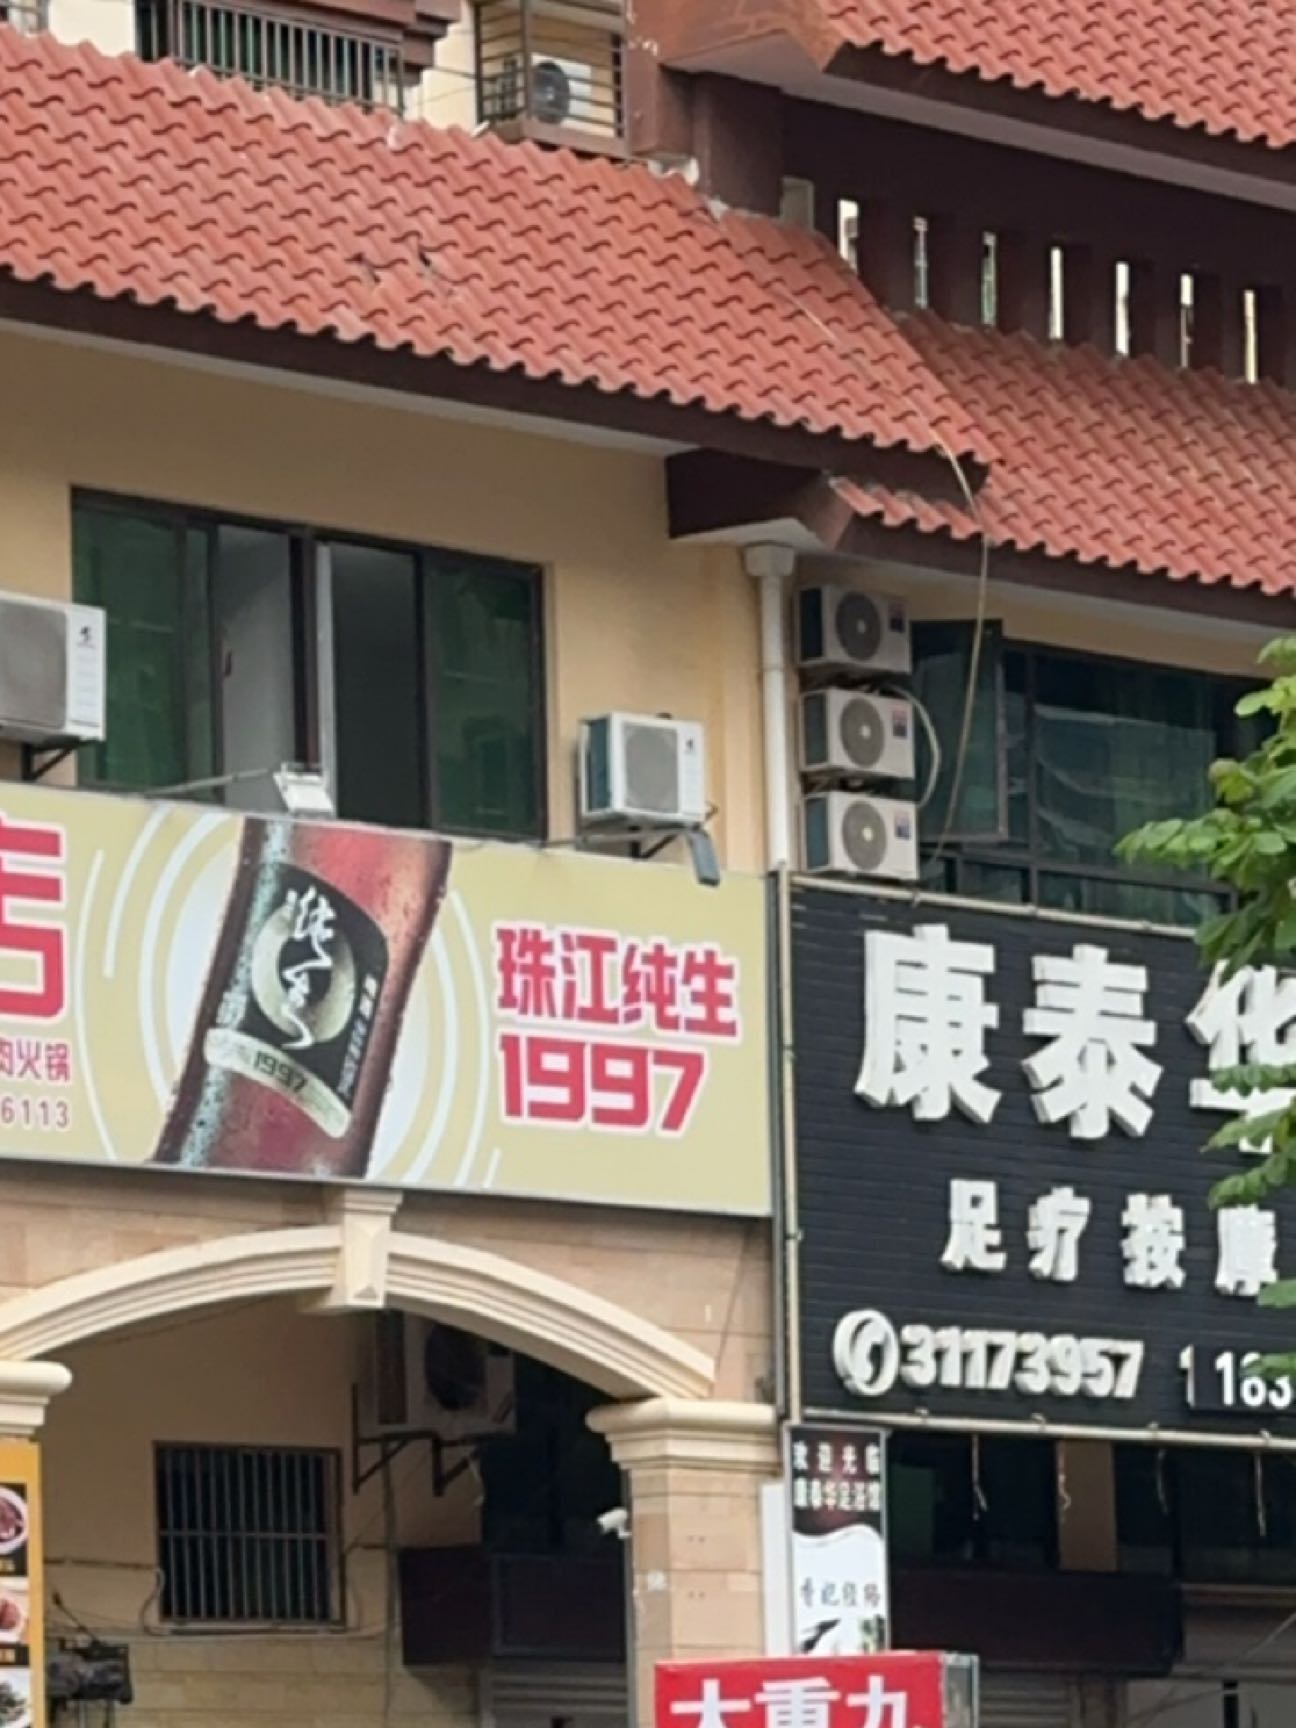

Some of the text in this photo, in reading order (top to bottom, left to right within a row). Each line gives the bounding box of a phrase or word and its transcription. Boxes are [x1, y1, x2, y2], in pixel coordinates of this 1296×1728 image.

[496, 926, 738, 1037] 珠江纯生
[255, 1051, 309, 1093] 1997
[499, 1034, 705, 1132] 1997
[901, 1323, 1144, 1398] 31173957
